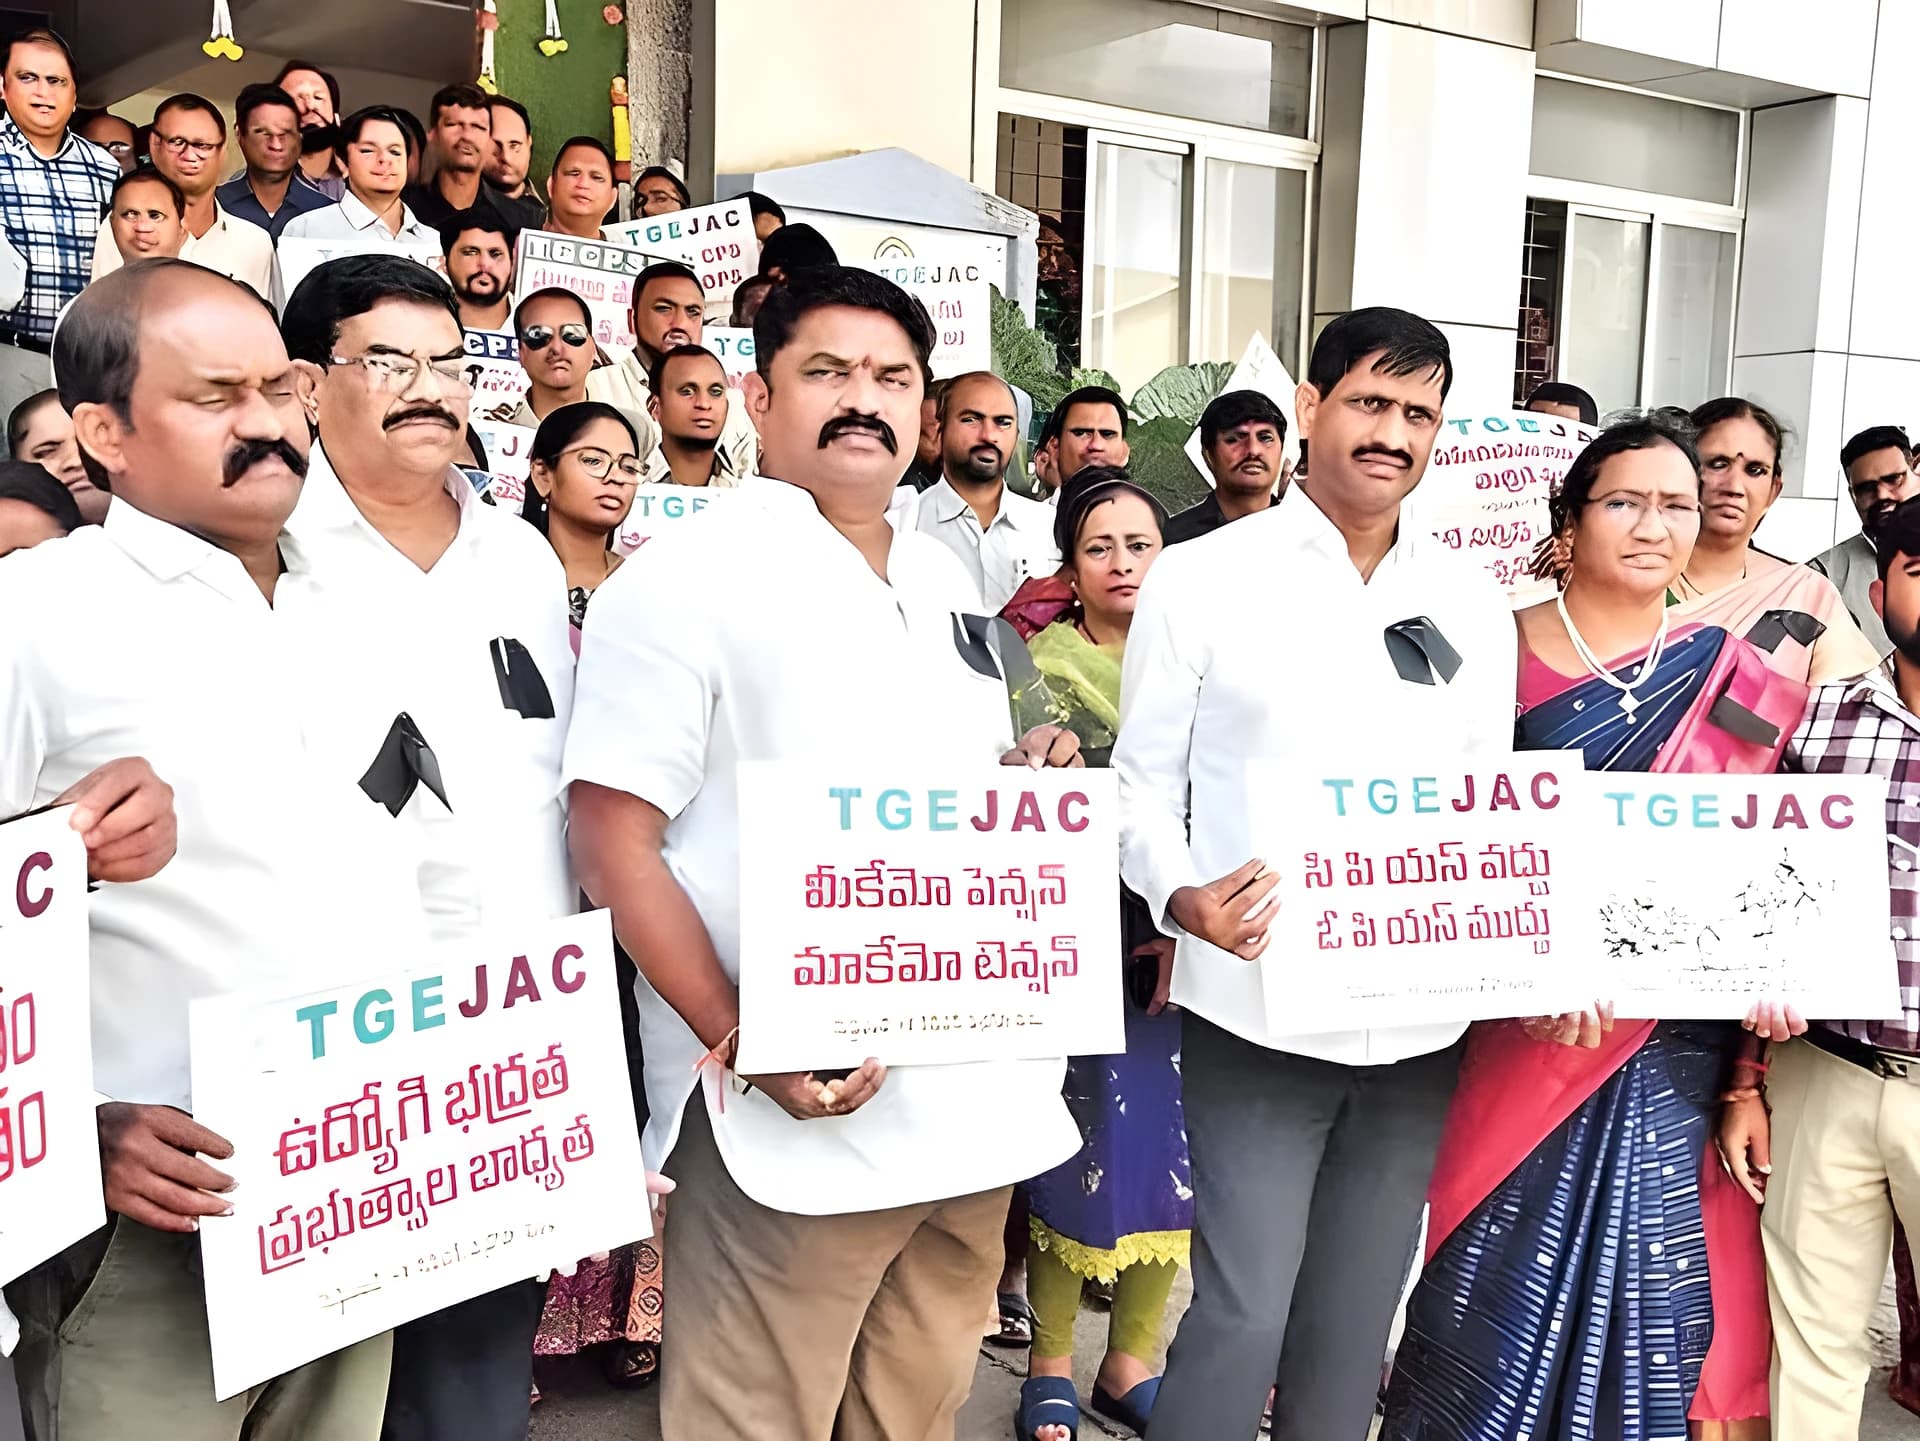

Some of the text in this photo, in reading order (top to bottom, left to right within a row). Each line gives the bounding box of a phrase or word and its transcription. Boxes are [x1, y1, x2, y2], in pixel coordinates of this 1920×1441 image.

[625, 210, 740, 246] TGEJAC
[830, 788, 1089, 832] TGEJAC
[1324, 772, 1560, 815] TGEJAC
[1605, 793, 1853, 829] TGEJAC
[805, 859, 951, 908] మీకేమో
[1304, 842, 1550, 896] సి పి యస్ వద్దు
[1316, 902, 1550, 953] ఓ పి యస్ ముద్దు
[794, 935, 961, 986] మాకేమో
[296, 944, 586, 1060] TGEJAC
[273, 1042, 569, 1174] ఉద్యోగి భద్రత
[258, 1163, 457, 1275] ప్రభుత్వాల
[470, 1114, 594, 1192] బాధ్యత
